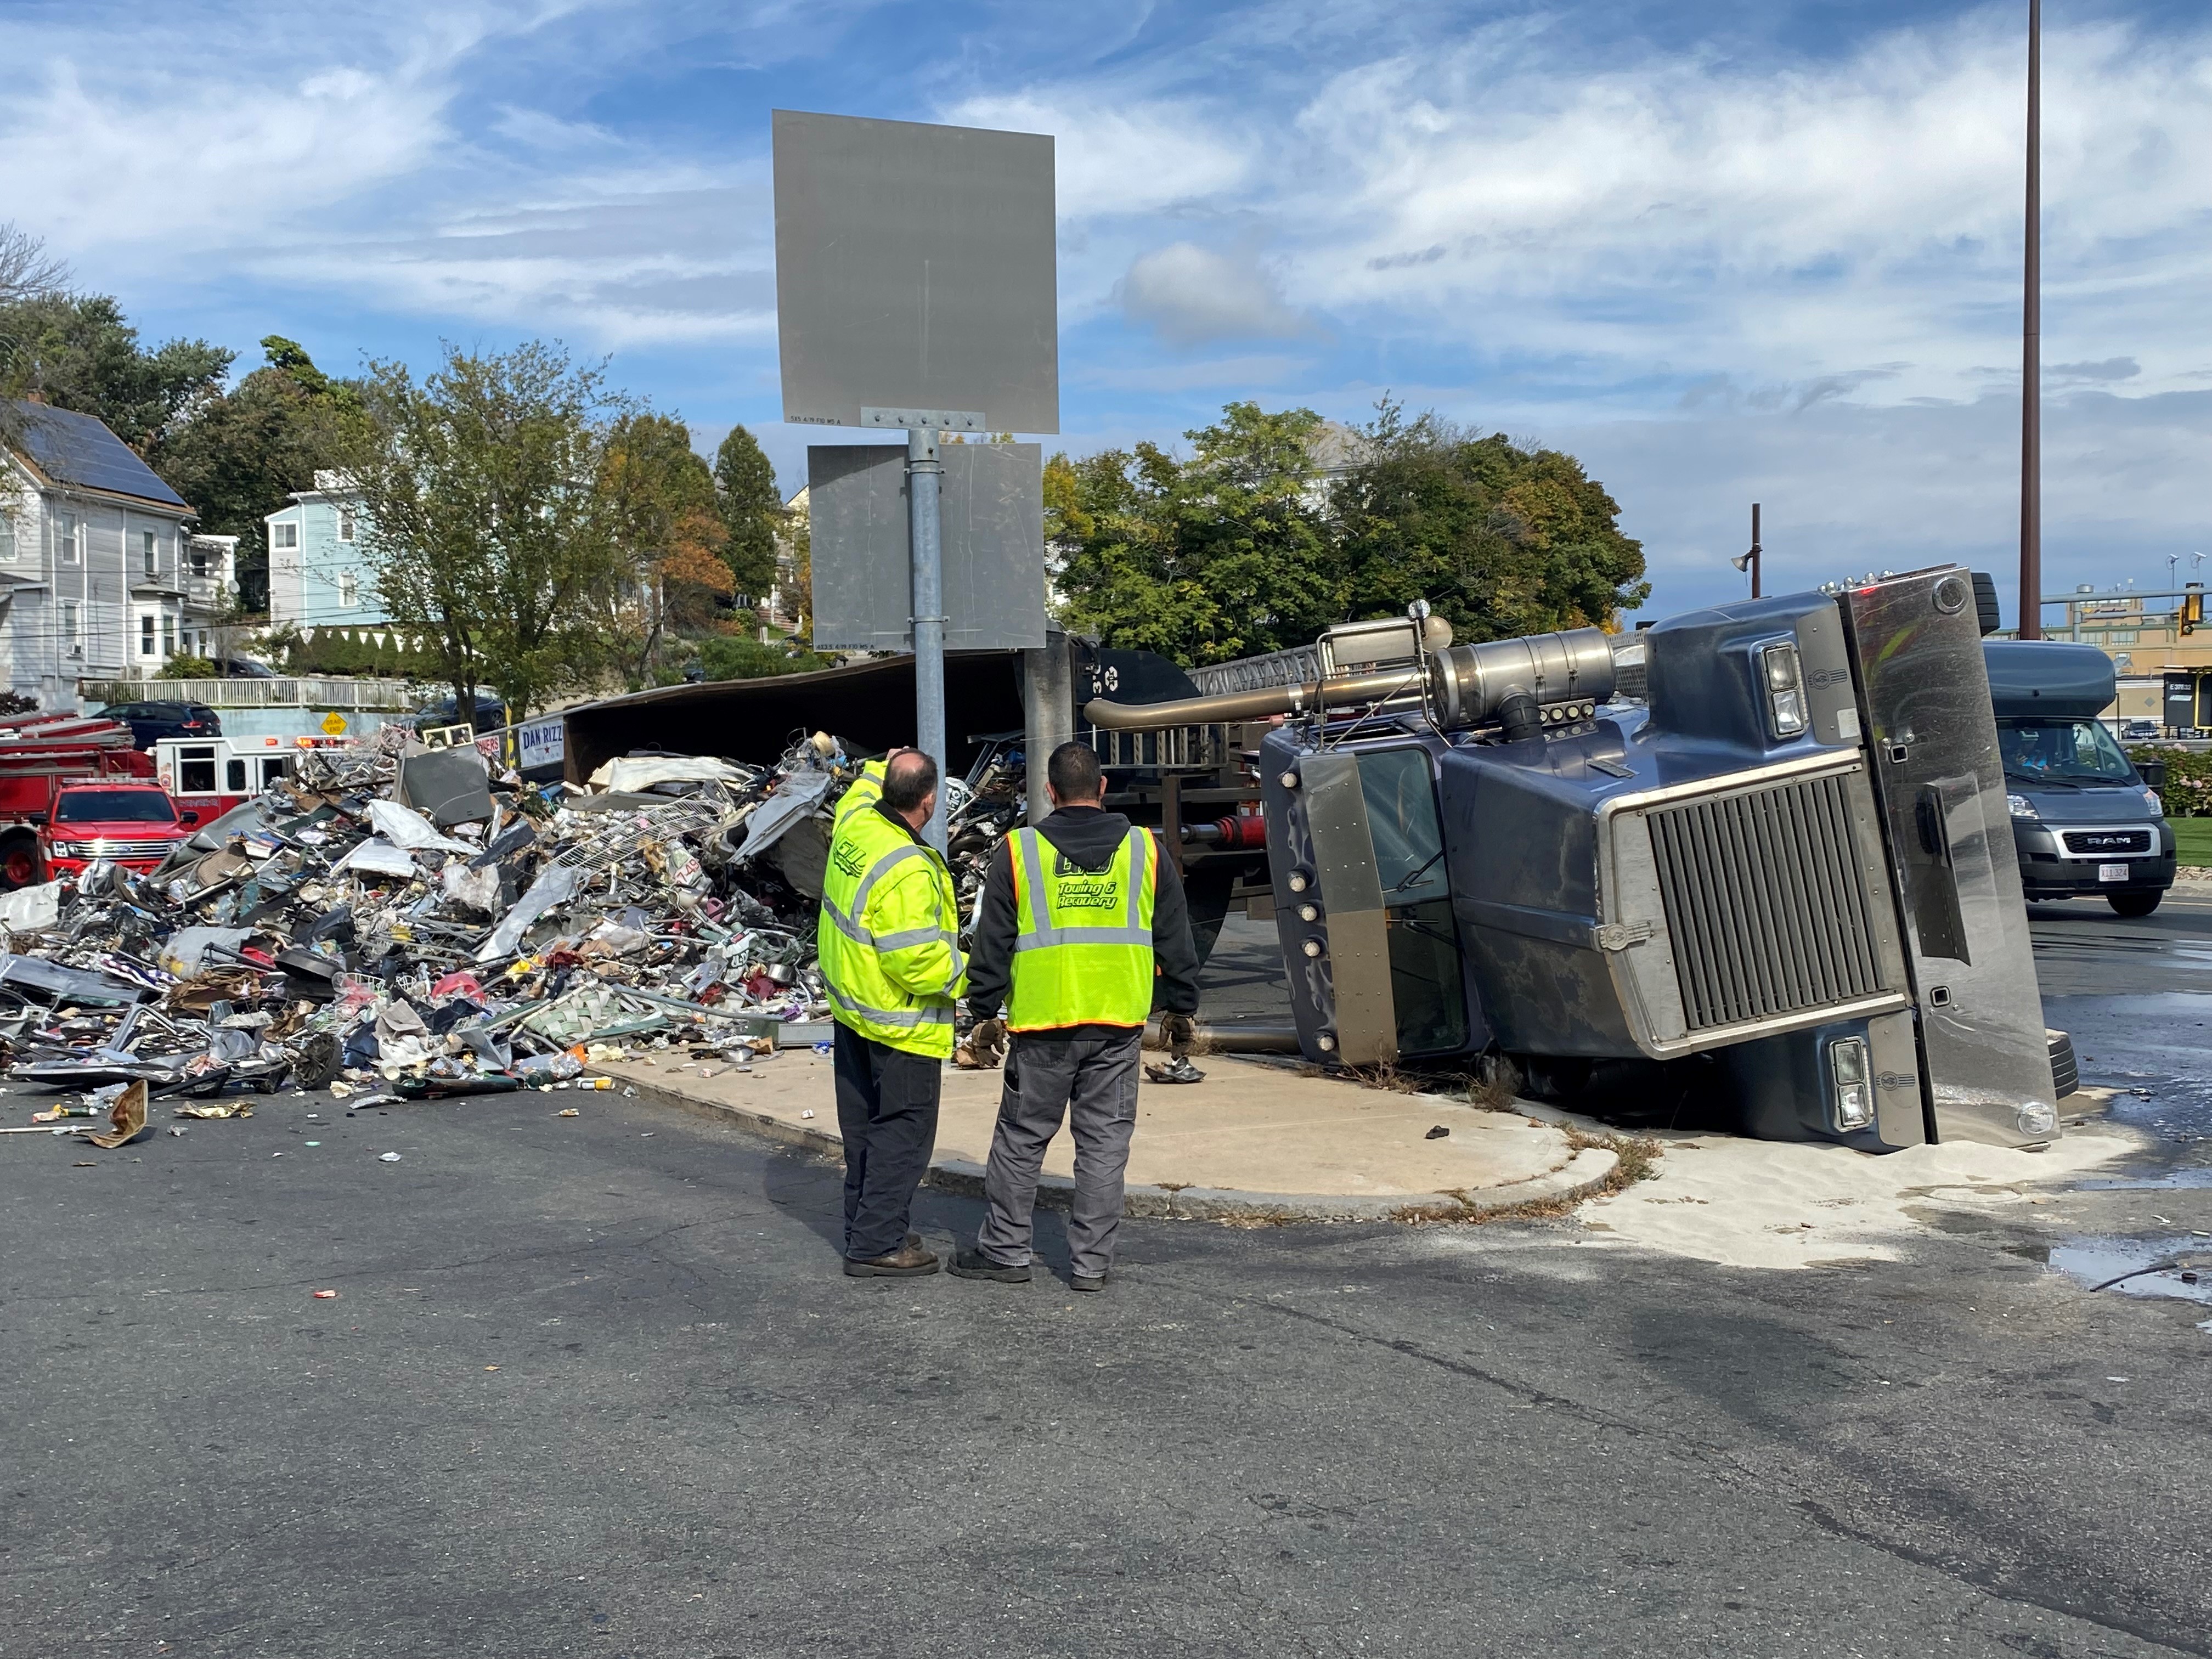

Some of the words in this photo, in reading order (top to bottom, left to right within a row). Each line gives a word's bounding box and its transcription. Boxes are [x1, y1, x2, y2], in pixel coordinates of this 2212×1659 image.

[523, 729, 541, 749] DAN
[543, 725, 563, 744] RIZZ
[1059, 879, 1104, 896] Towing
[1104, 881, 1117, 894] &
[1057, 895, 1118, 910] Recovery
